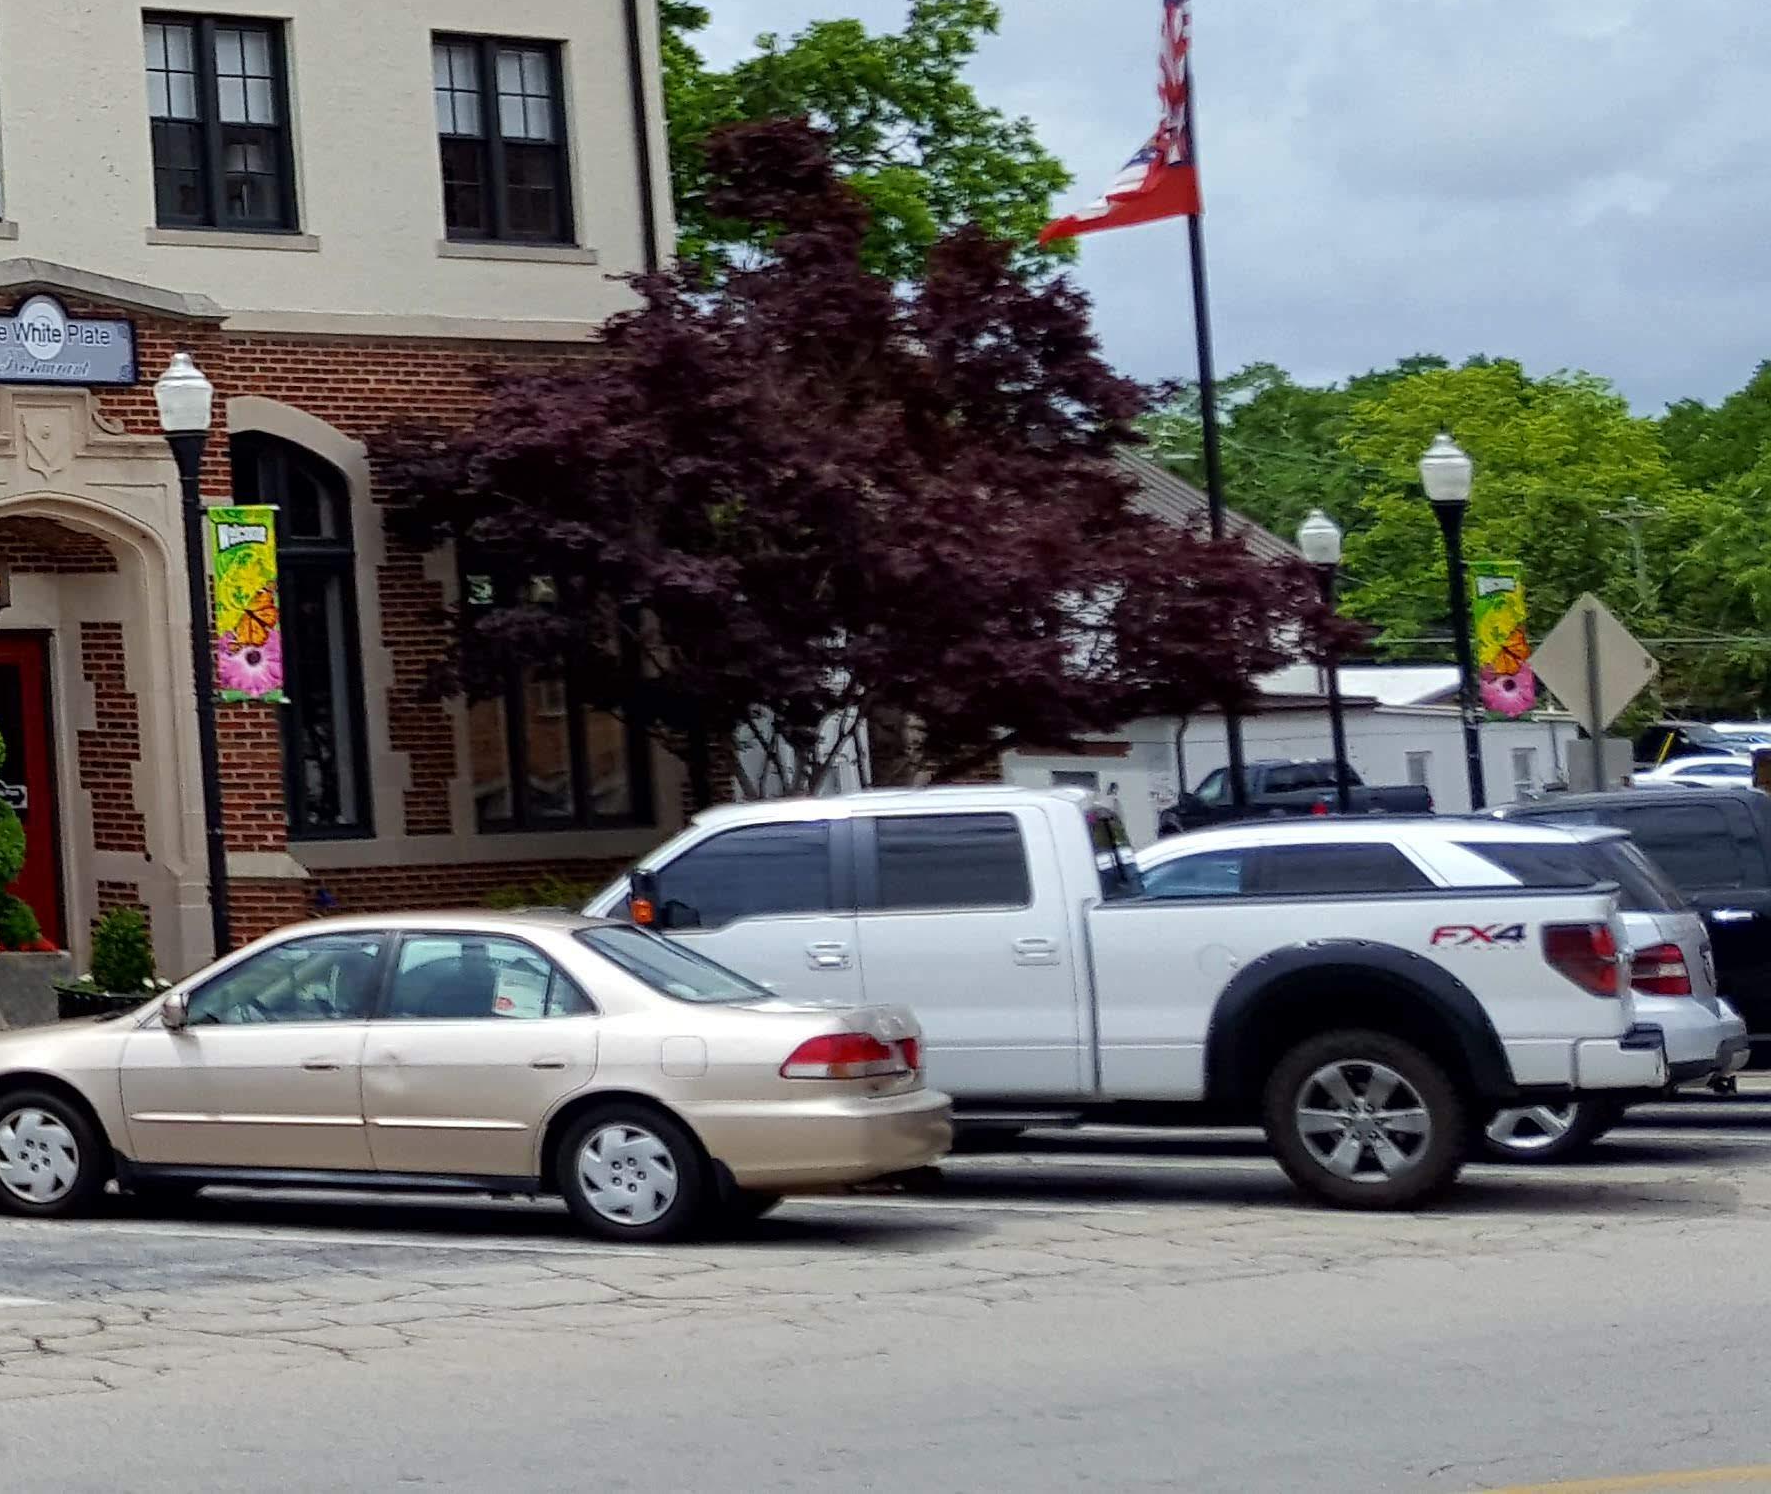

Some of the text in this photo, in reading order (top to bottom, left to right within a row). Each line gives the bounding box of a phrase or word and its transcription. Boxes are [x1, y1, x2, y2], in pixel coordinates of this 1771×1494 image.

[11, 321, 62, 344] White
[68, 324, 110, 345] Plate
[1430, 923, 1526, 945] FX4
